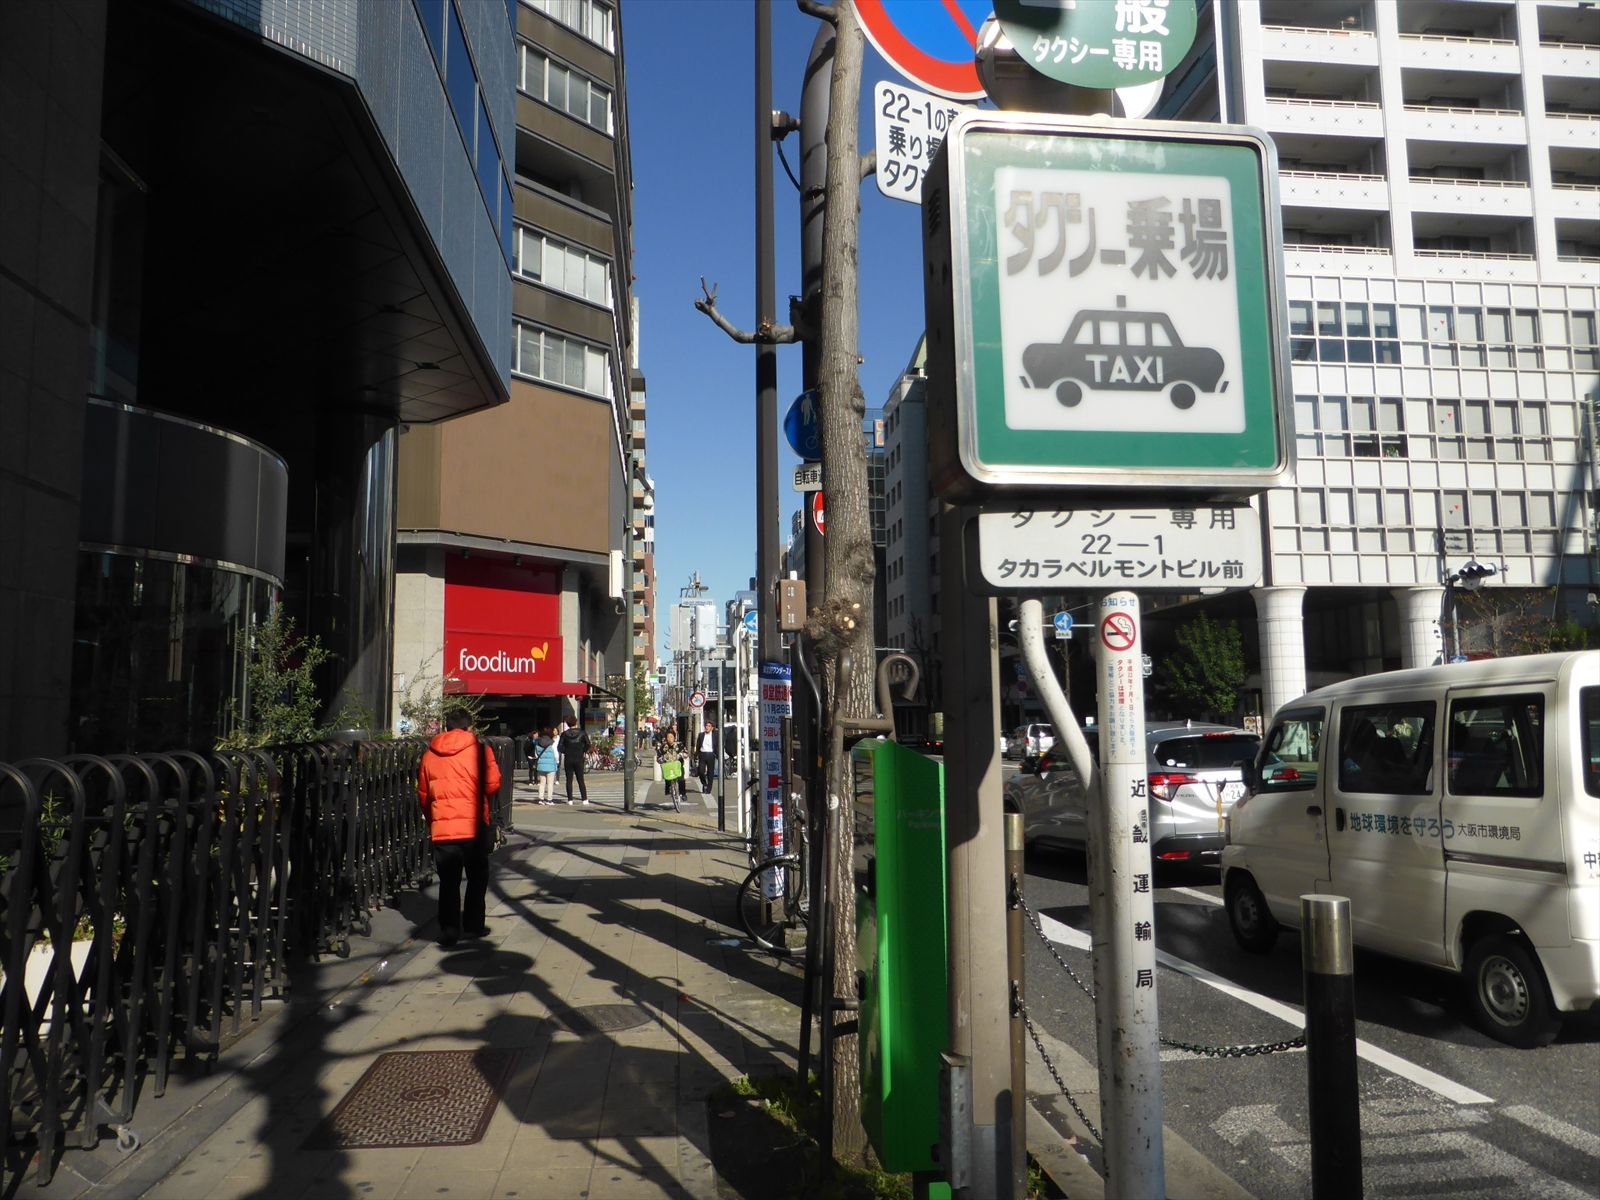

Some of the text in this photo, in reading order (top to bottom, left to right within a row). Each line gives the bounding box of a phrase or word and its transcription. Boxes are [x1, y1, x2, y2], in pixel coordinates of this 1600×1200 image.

[1032, 35, 1163, 71] タクシー専用
[1004, 190, 1229, 281] タクシー乗場
[1085, 354, 1164, 384] TAXI
[1011, 508, 1236, 530] タクシー専用
[998, 559, 1244, 579] タカラベルモントビル前
[459, 648, 536, 673] foodium
[1350, 812, 1521, 841] 地球環境を守ろう 大阪市環境局
